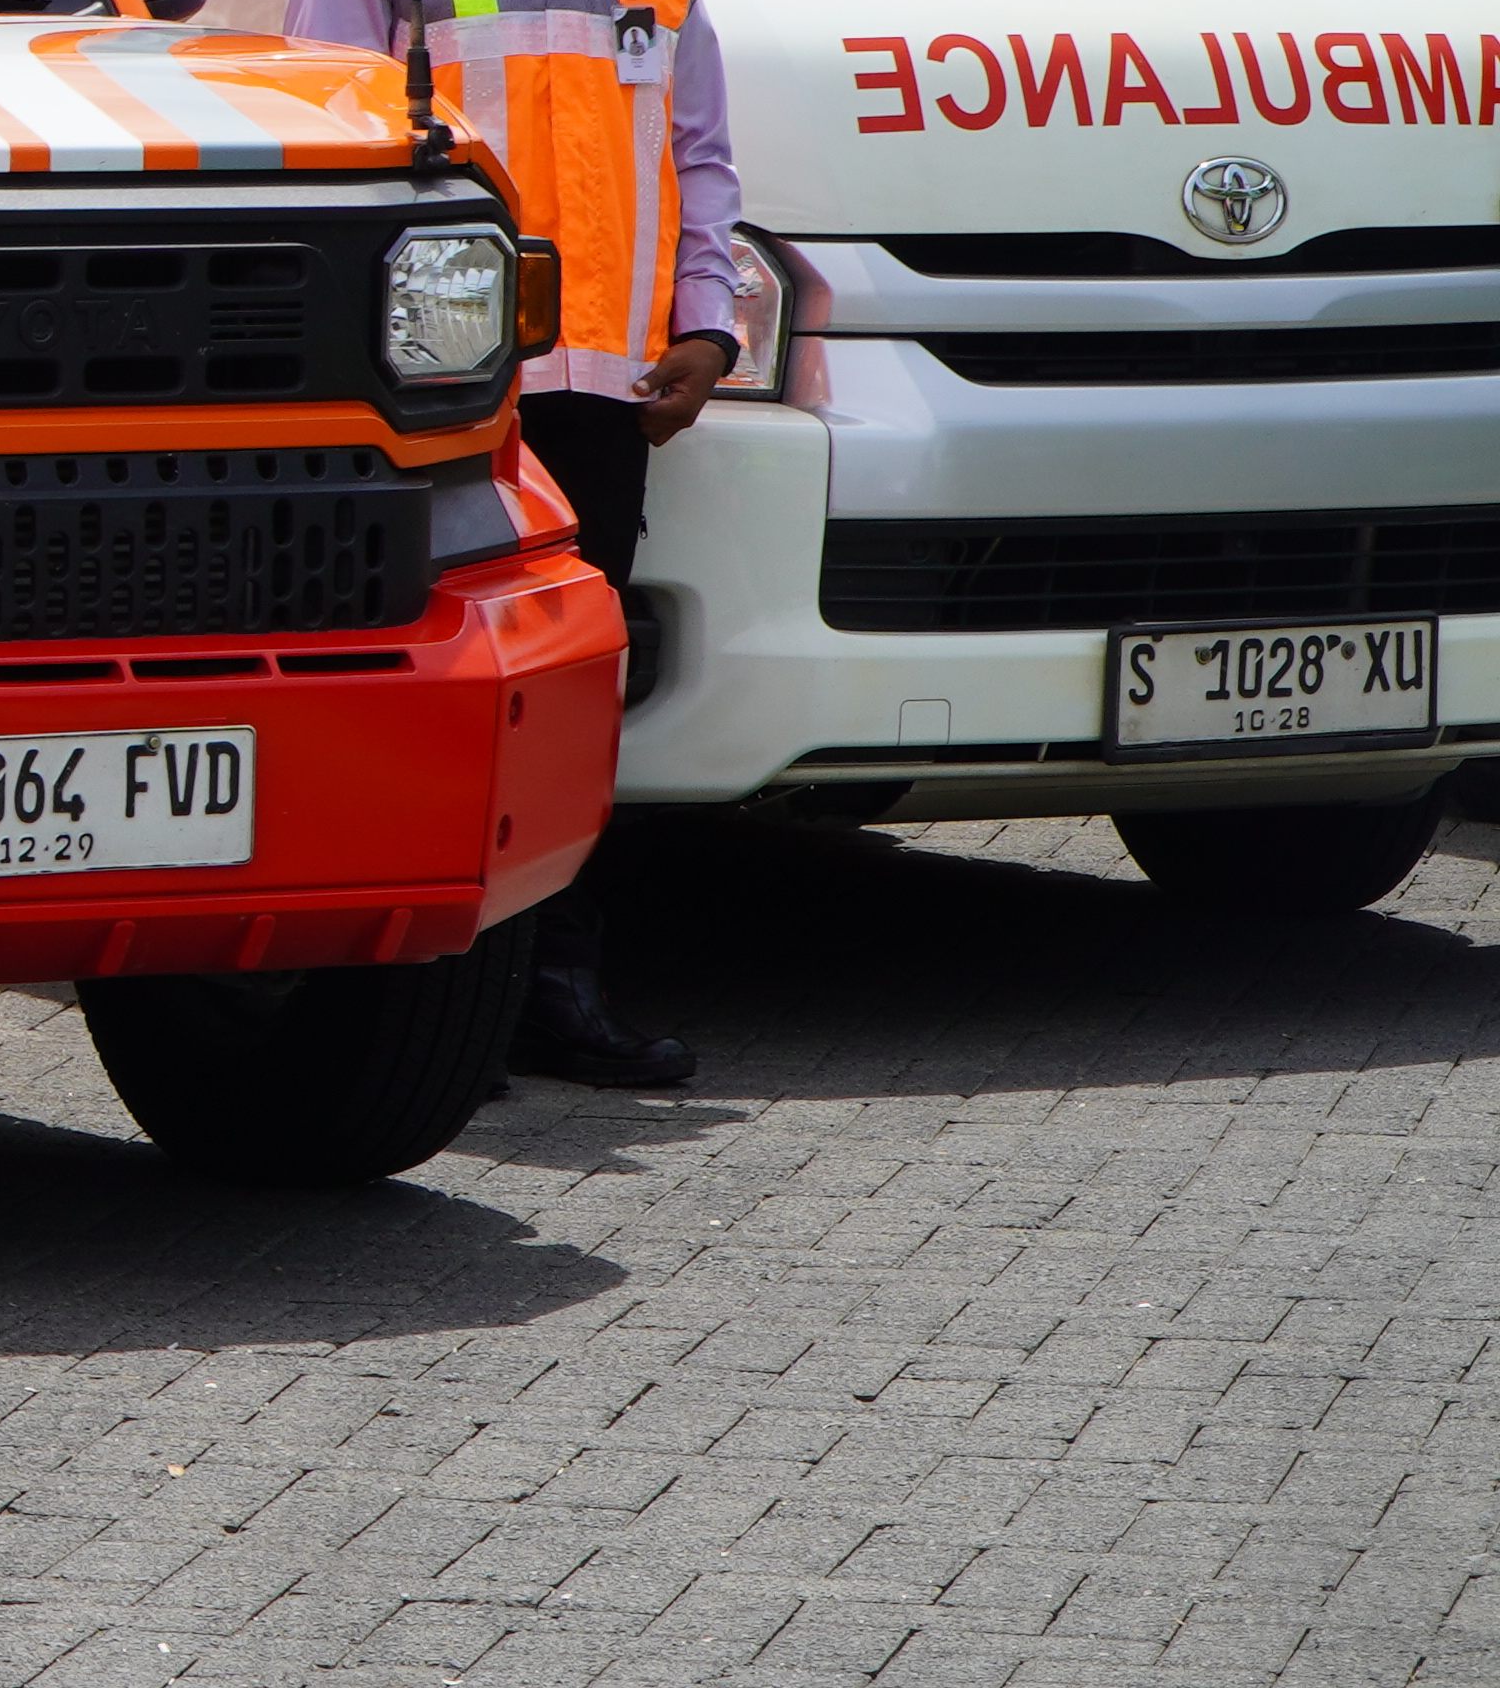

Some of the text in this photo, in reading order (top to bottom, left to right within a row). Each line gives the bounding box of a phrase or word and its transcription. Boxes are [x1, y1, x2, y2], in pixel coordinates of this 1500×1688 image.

[1128, 629, 1424, 706] S 1028 XU
[124, 741, 242, 819] FVD
